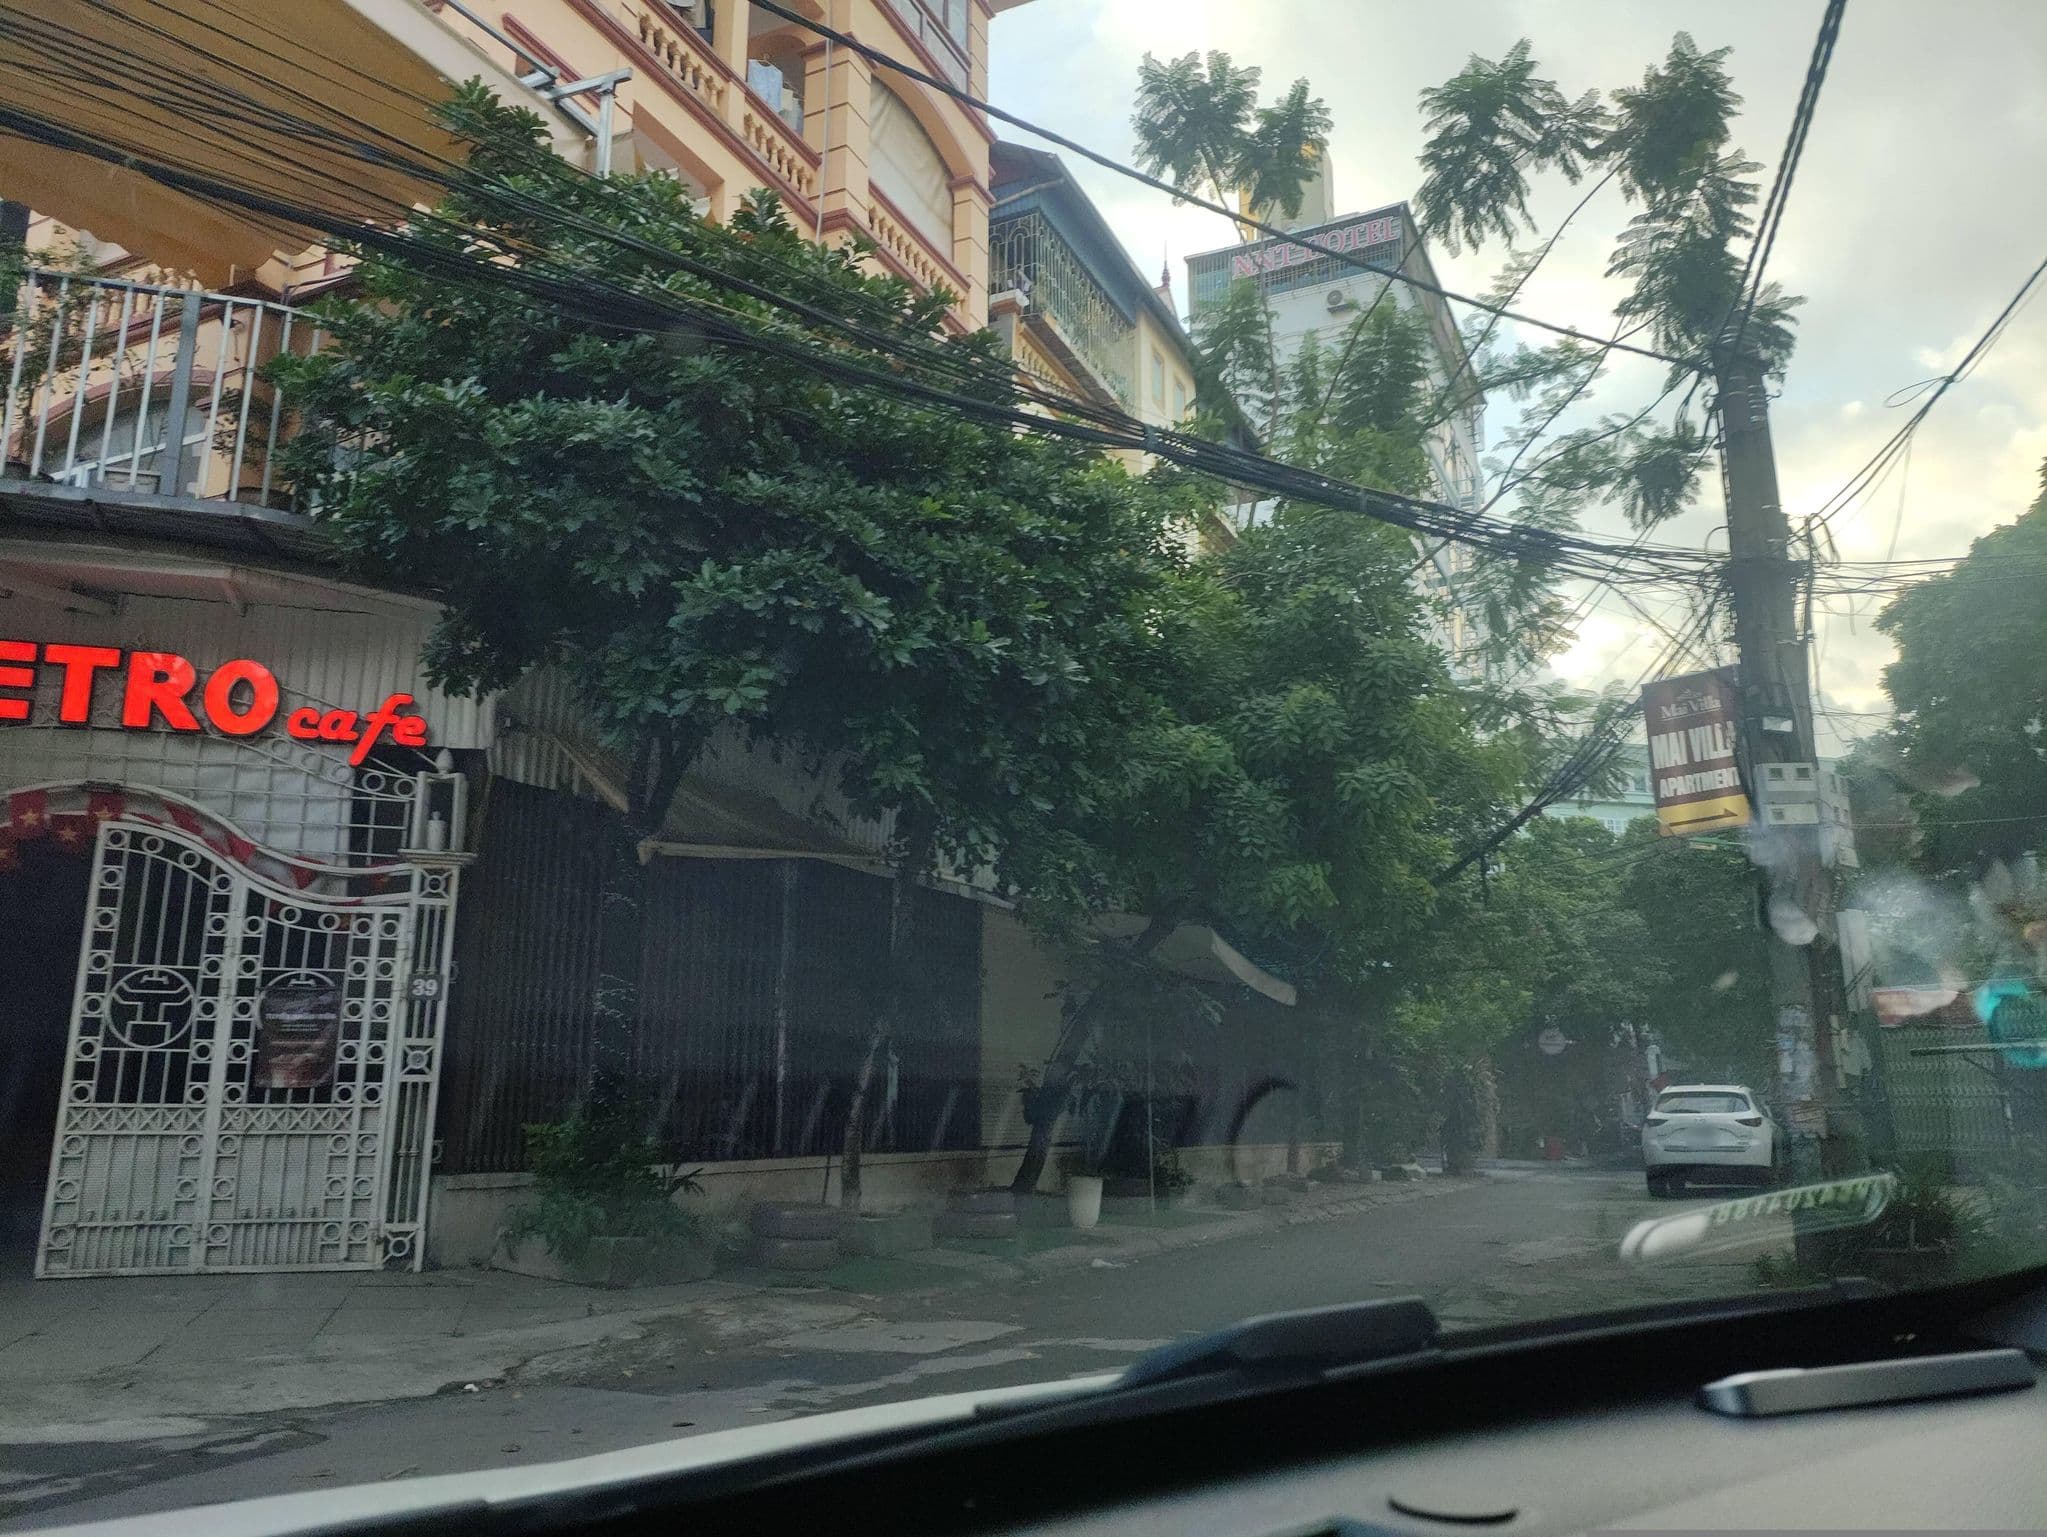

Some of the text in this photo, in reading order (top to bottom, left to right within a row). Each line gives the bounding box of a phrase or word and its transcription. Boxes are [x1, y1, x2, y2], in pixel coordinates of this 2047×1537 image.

[287, 693, 428, 766] cafe
[1651, 730, 1689, 769] MAI
[412, 979, 438, 997] 39
